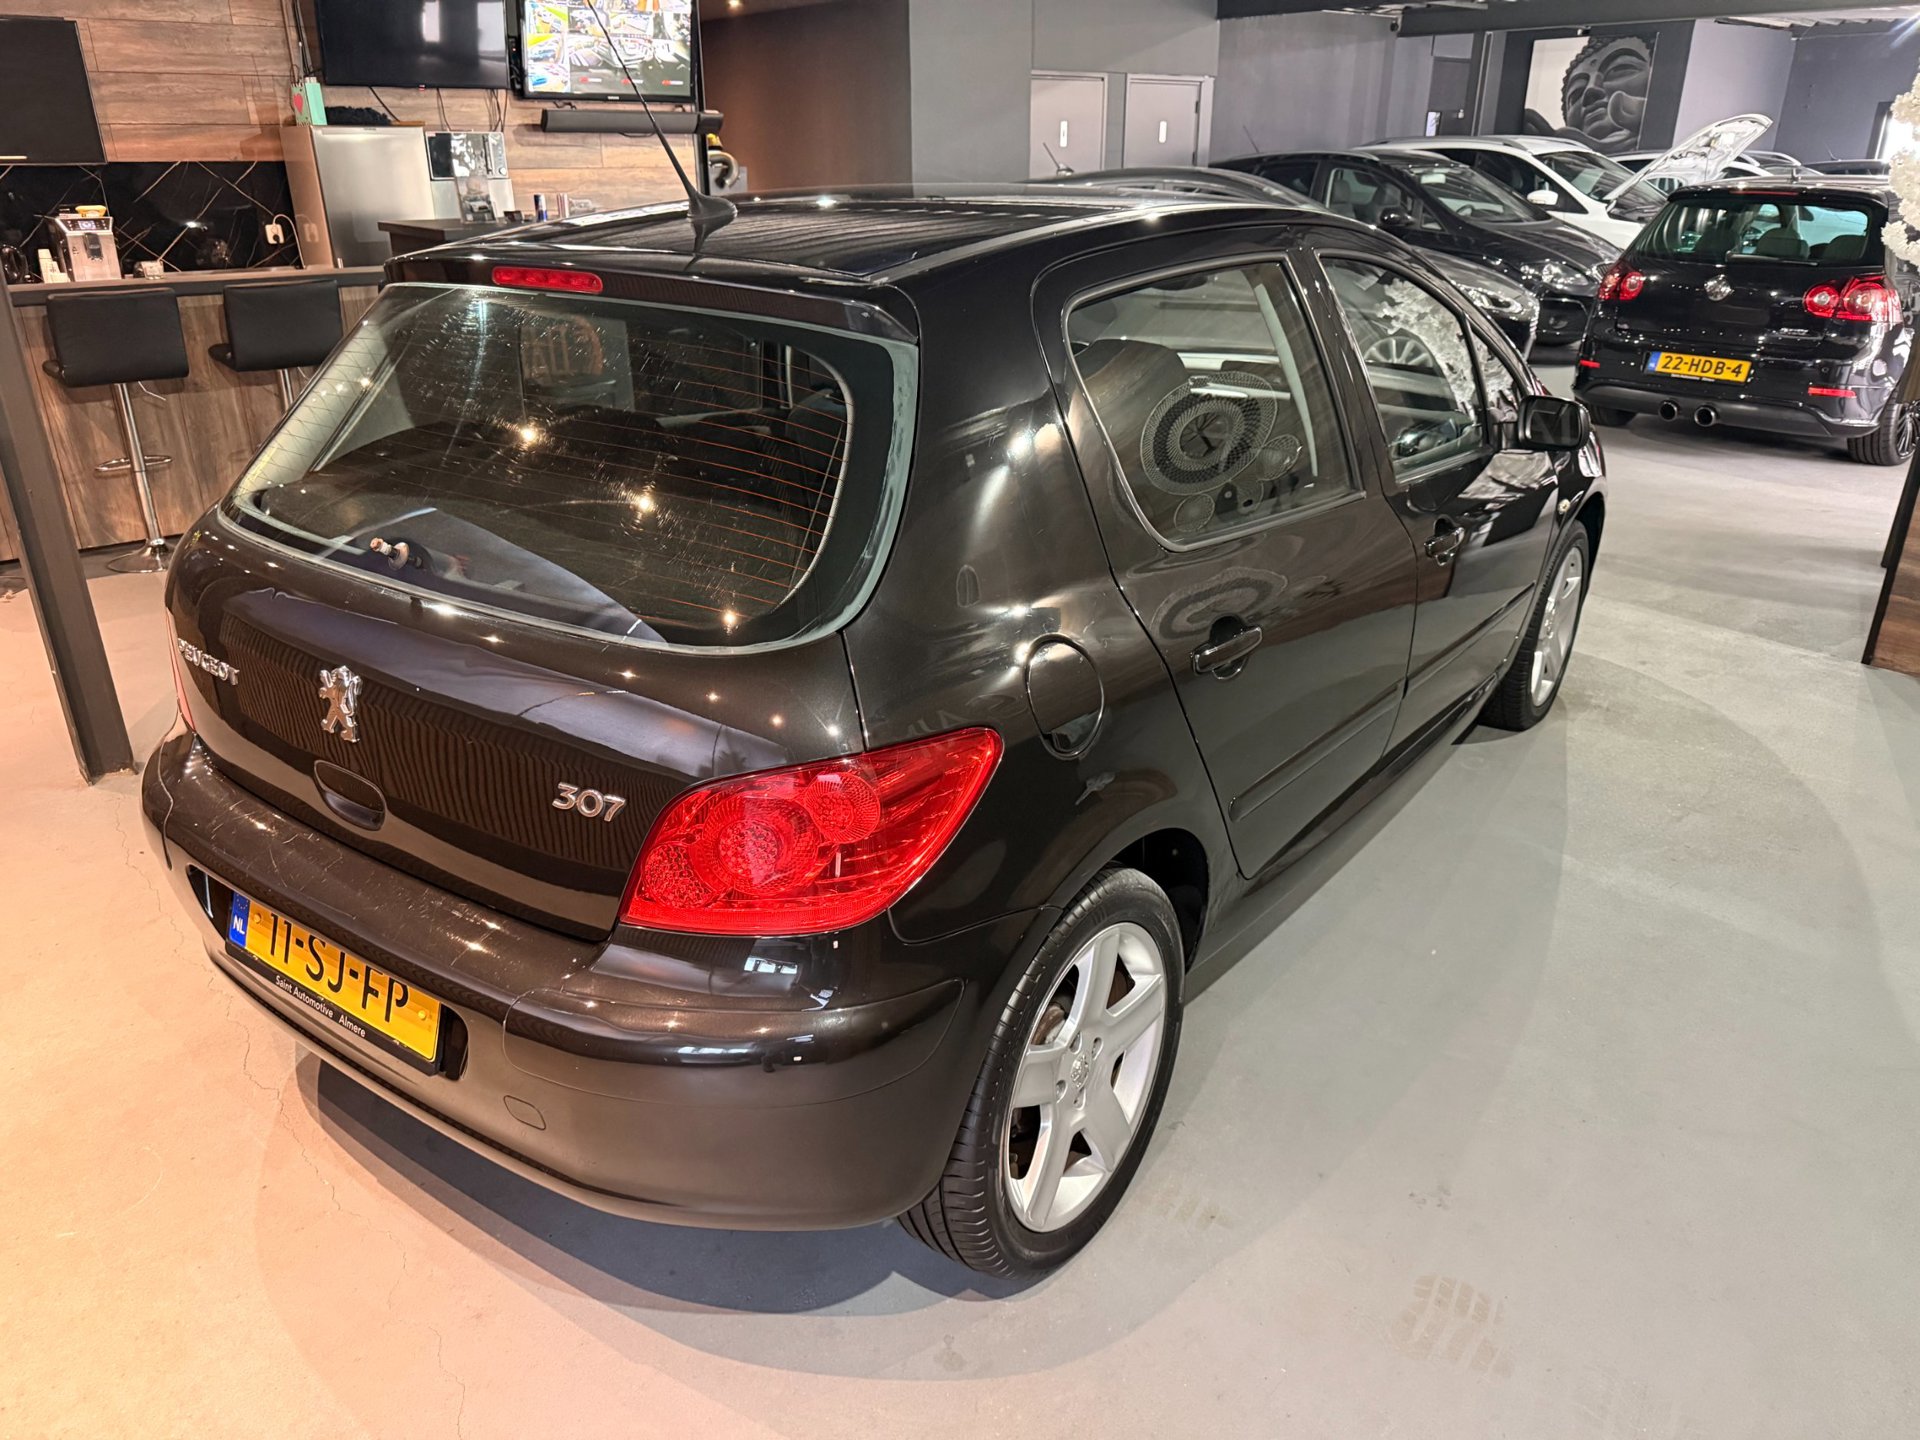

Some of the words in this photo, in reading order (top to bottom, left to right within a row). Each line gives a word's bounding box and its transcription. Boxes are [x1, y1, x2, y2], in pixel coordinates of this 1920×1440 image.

[1661, 355, 1743, 377] 22-HDB-4
[552, 782, 626, 822] 307
[232, 914, 245, 935] NL
[270, 912, 409, 1023] 11-SJ-FP
[275, 975, 293, 994] Saint
[293, 986, 334, 1018] Automotive
[338, 1014, 366, 1037] Almere
